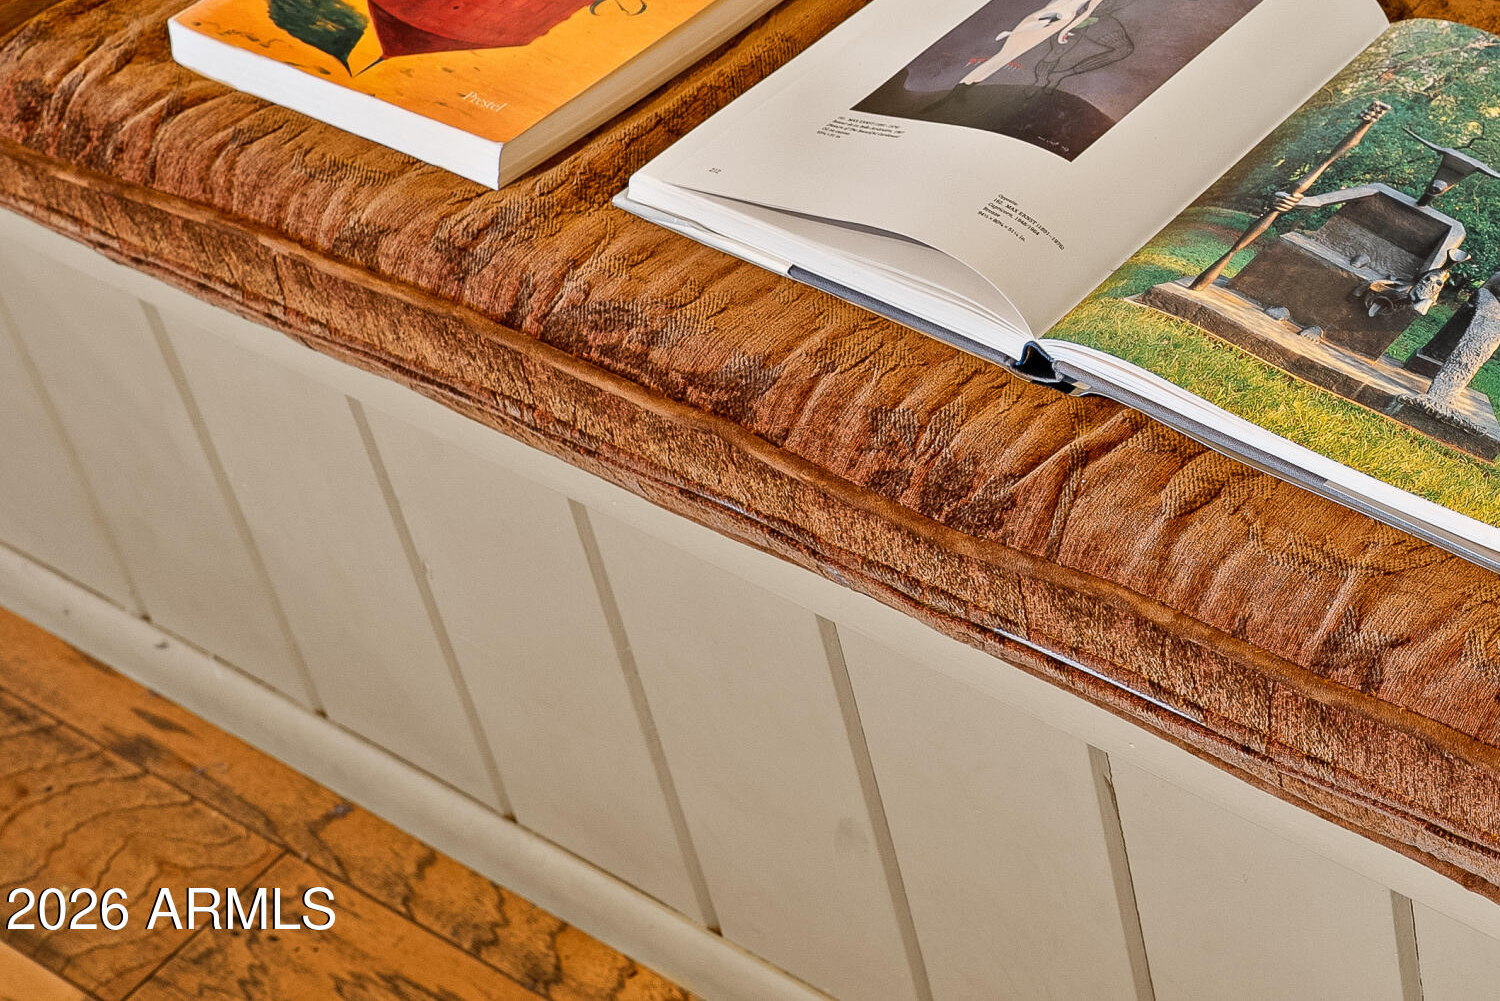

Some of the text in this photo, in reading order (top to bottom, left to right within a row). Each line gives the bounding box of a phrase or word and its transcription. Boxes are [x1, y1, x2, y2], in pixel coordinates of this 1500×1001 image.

[463, 91, 508, 113] Prestel
[1005, 204, 1018, 213] MAX
[1018, 211, 1038, 225] ERNST
